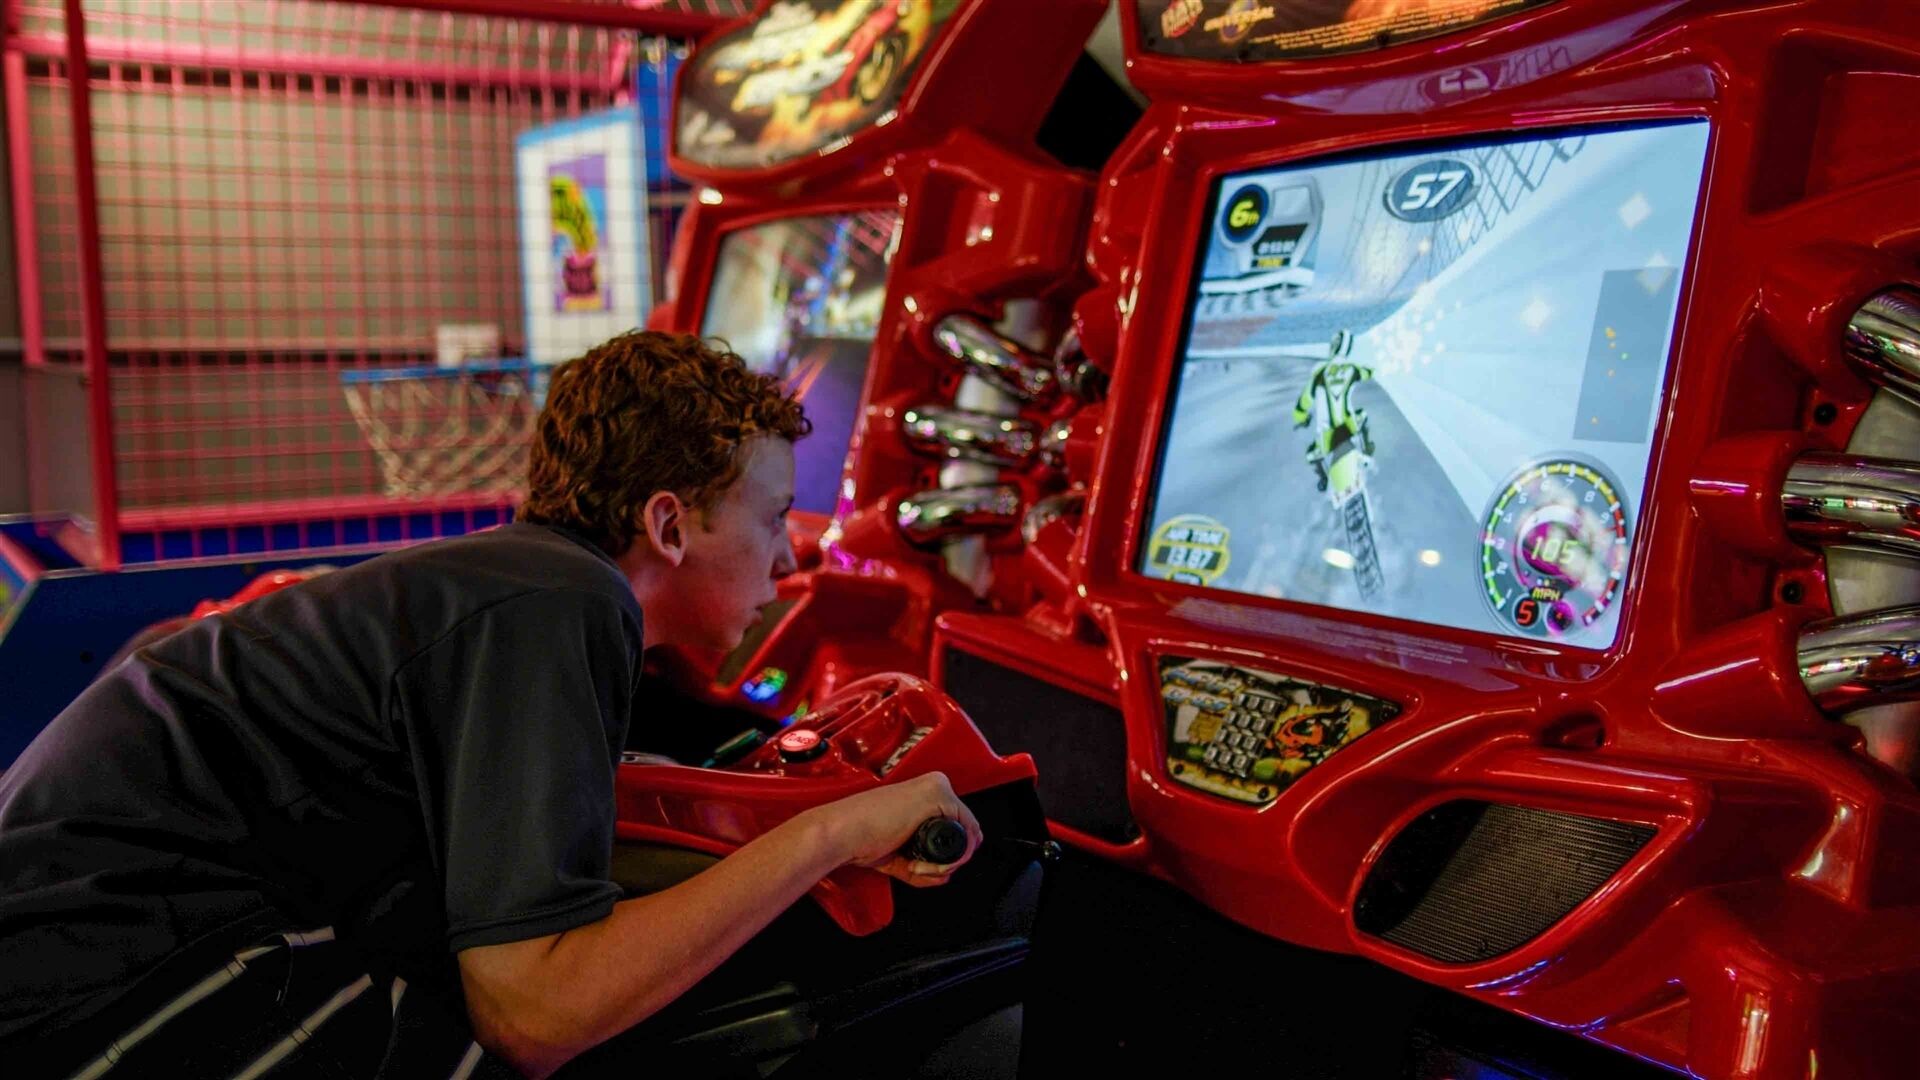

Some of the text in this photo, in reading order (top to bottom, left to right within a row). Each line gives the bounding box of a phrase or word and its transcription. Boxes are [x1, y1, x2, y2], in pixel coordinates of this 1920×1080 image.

[1401, 169, 1467, 211] 57
[1519, 493, 1528, 504] 5
[1503, 513, 1512, 523] 4
[1531, 536, 1579, 564] 105
[1497, 561, 1508, 574] 2
[1532, 586, 1562, 601] MPH
[1517, 599, 1535, 625] 5
